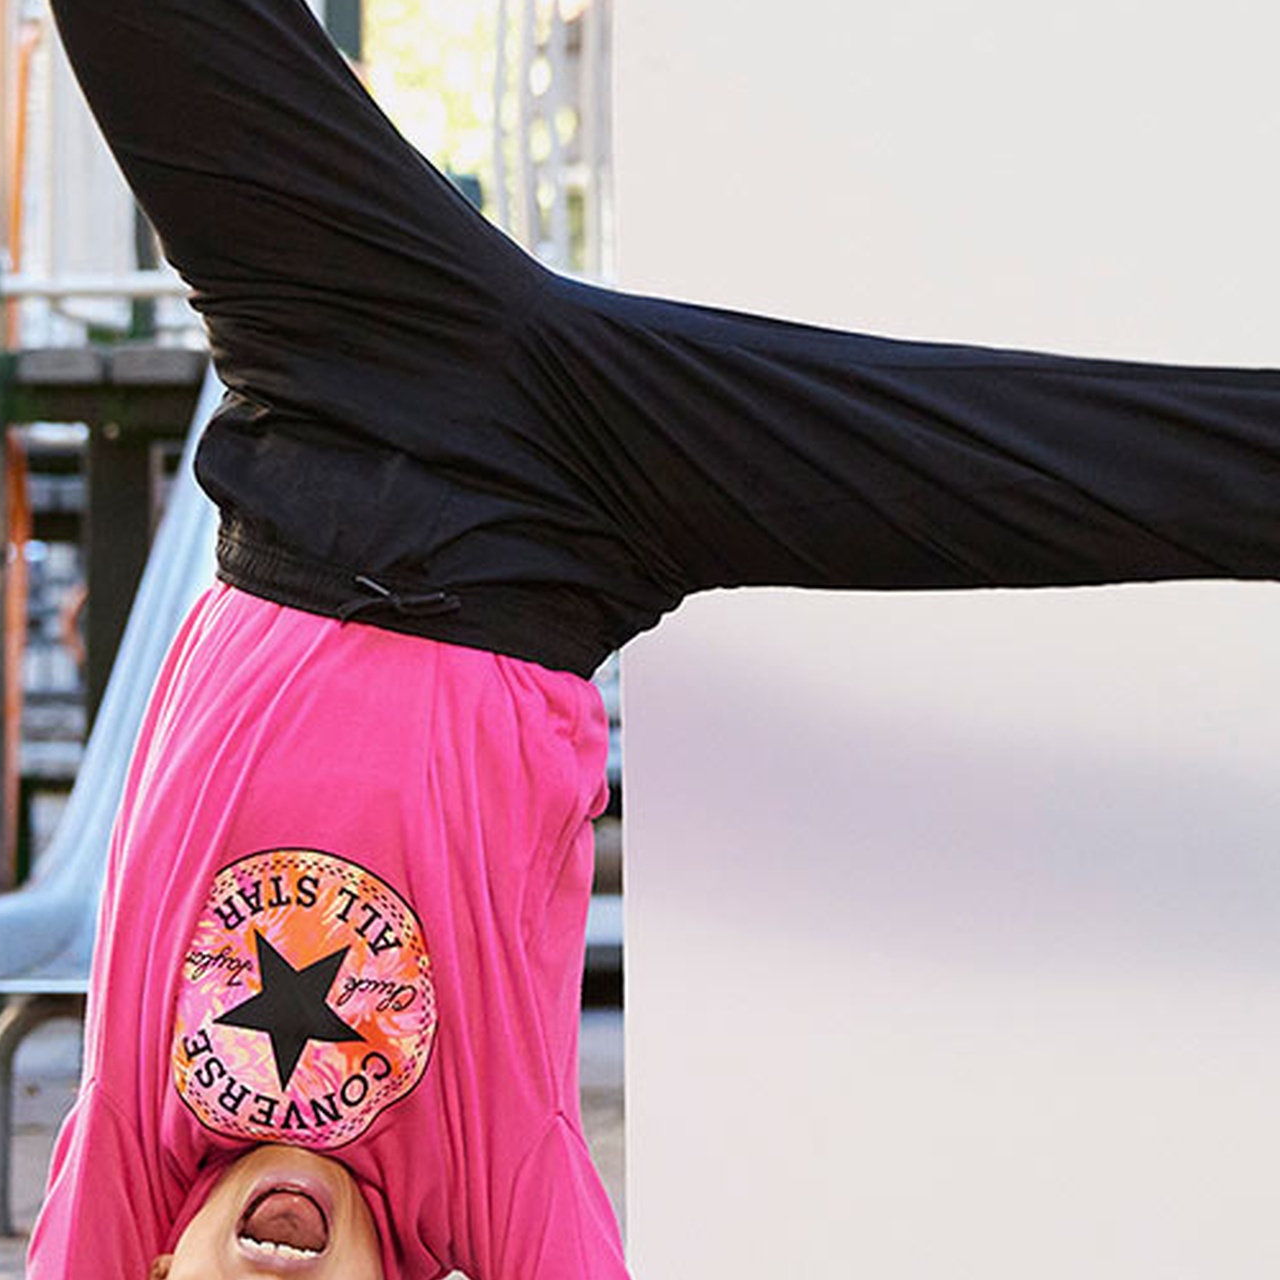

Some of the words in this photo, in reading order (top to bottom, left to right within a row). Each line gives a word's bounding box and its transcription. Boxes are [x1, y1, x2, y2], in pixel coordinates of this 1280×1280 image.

[214, 875, 320, 931] STAR
[337, 888, 402, 957] ALL
[337, 976, 418, 1013] Chuck
[183, 1029, 392, 1129] CONVERSE
